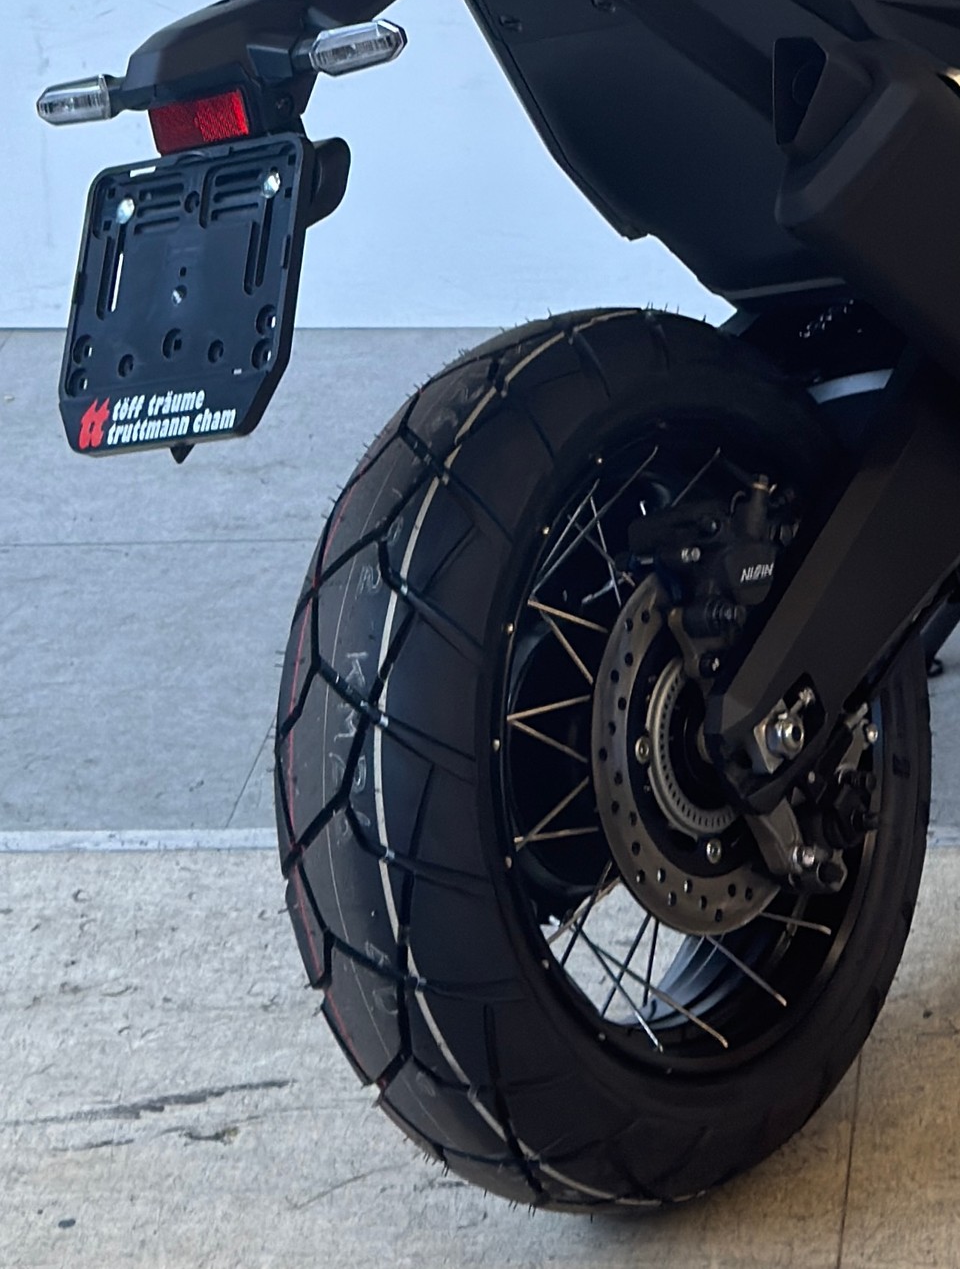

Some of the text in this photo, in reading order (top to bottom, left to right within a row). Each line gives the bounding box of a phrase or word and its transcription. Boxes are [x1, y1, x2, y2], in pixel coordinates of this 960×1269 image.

[112, 390, 205, 421] töff träume
[107, 408, 236, 445] truttmann cham
